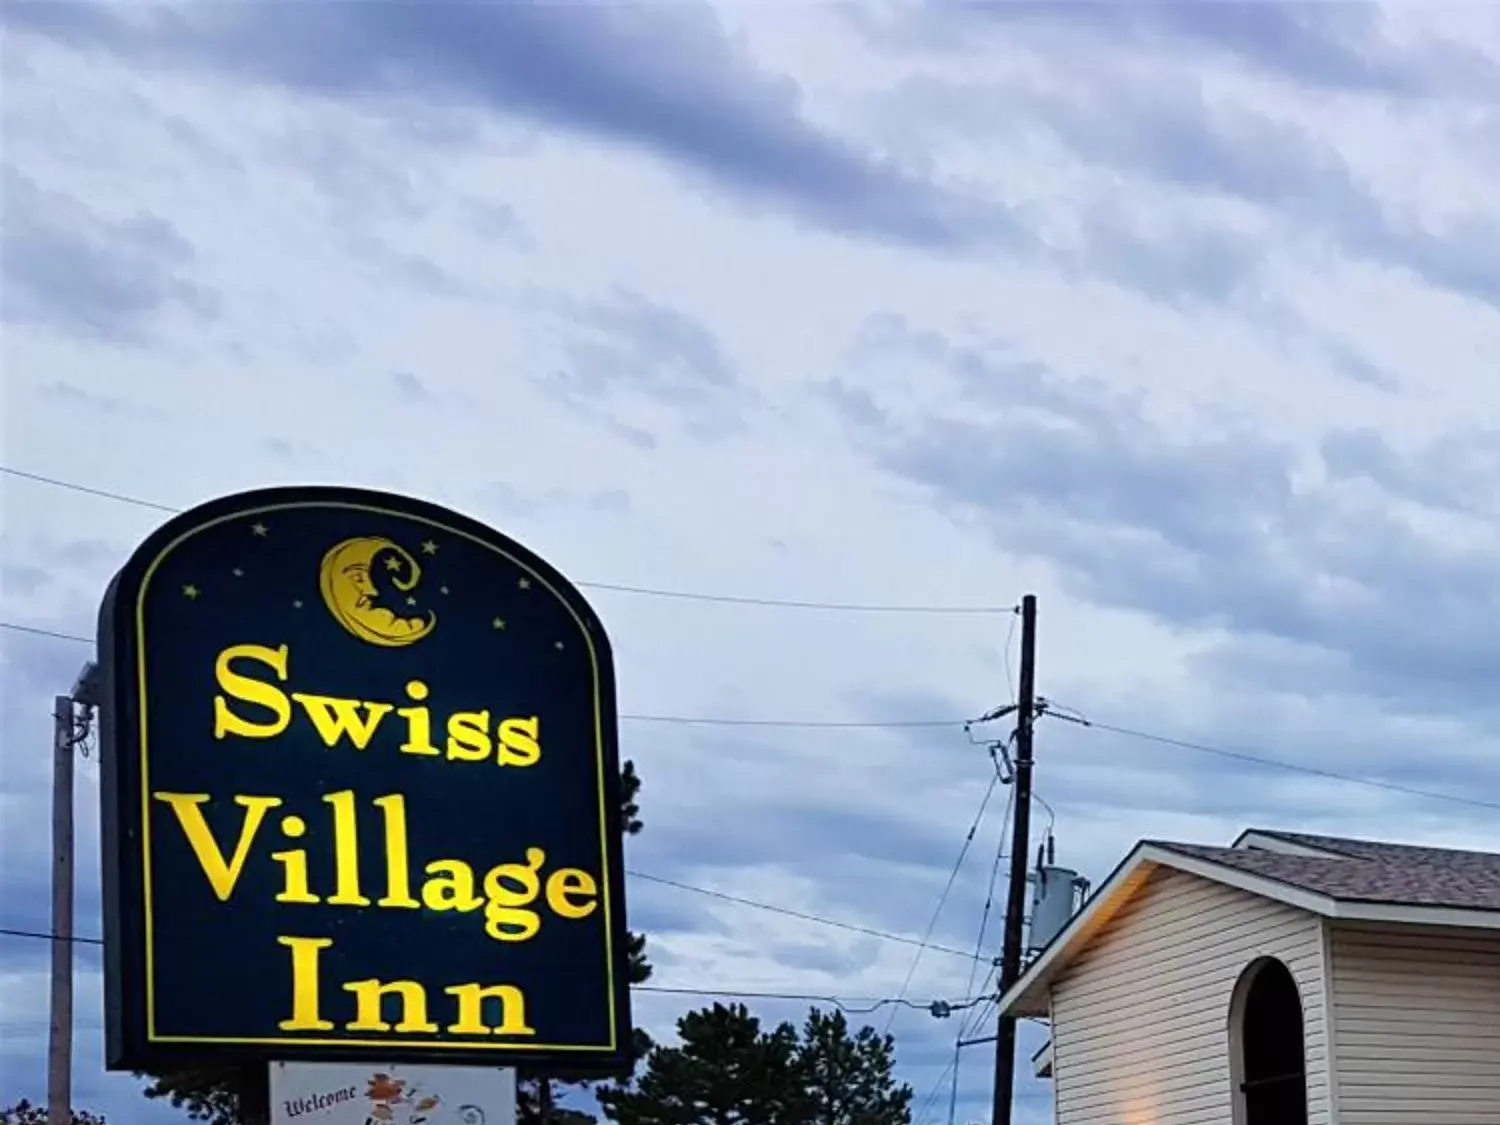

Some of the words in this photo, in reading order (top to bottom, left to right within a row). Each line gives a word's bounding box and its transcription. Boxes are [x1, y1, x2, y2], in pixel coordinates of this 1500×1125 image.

[214, 644, 541, 767] Swiss
[153, 790, 598, 942] Village
[277, 935, 537, 1037] Inn
[284, 1086, 357, 1118] Welcome
